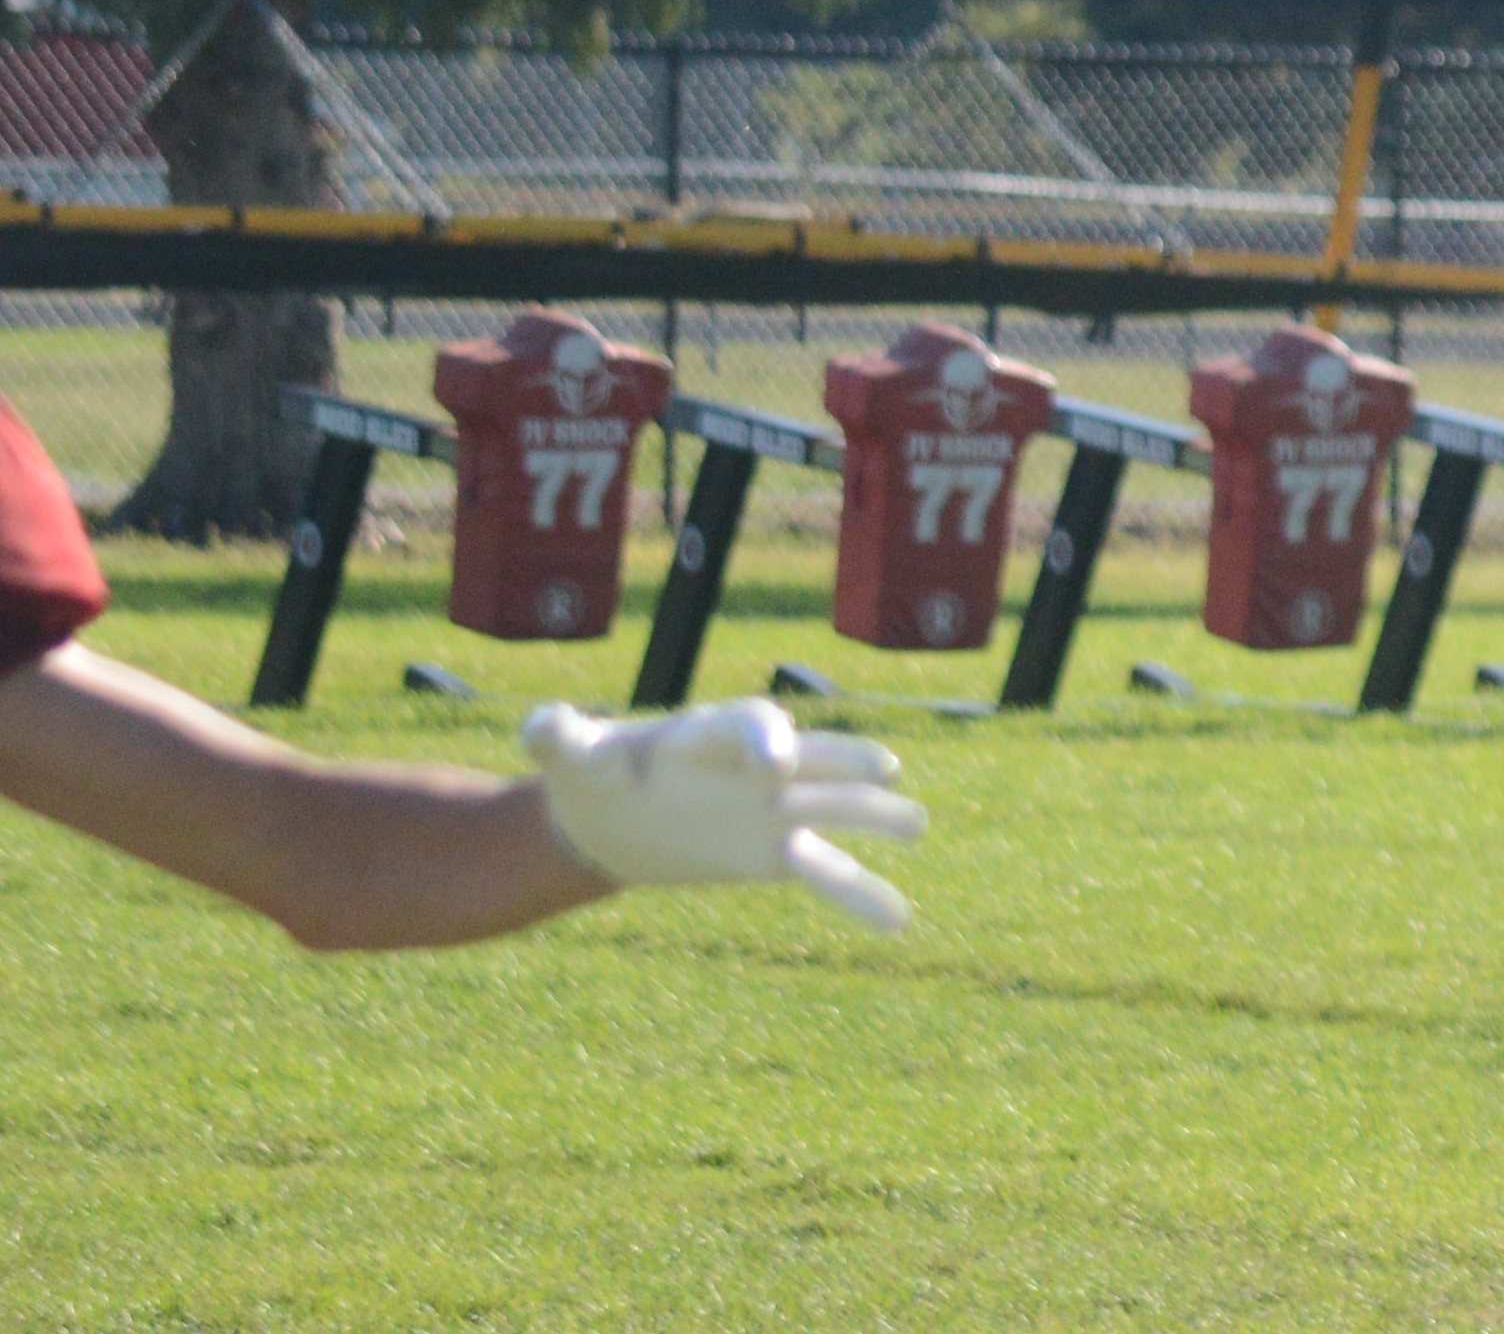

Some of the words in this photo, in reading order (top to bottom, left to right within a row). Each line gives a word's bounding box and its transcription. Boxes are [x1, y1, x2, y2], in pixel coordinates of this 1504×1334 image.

[523, 449, 623, 530] 77
[908, 465, 1005, 545] 77
[1275, 466, 1369, 544] 77
